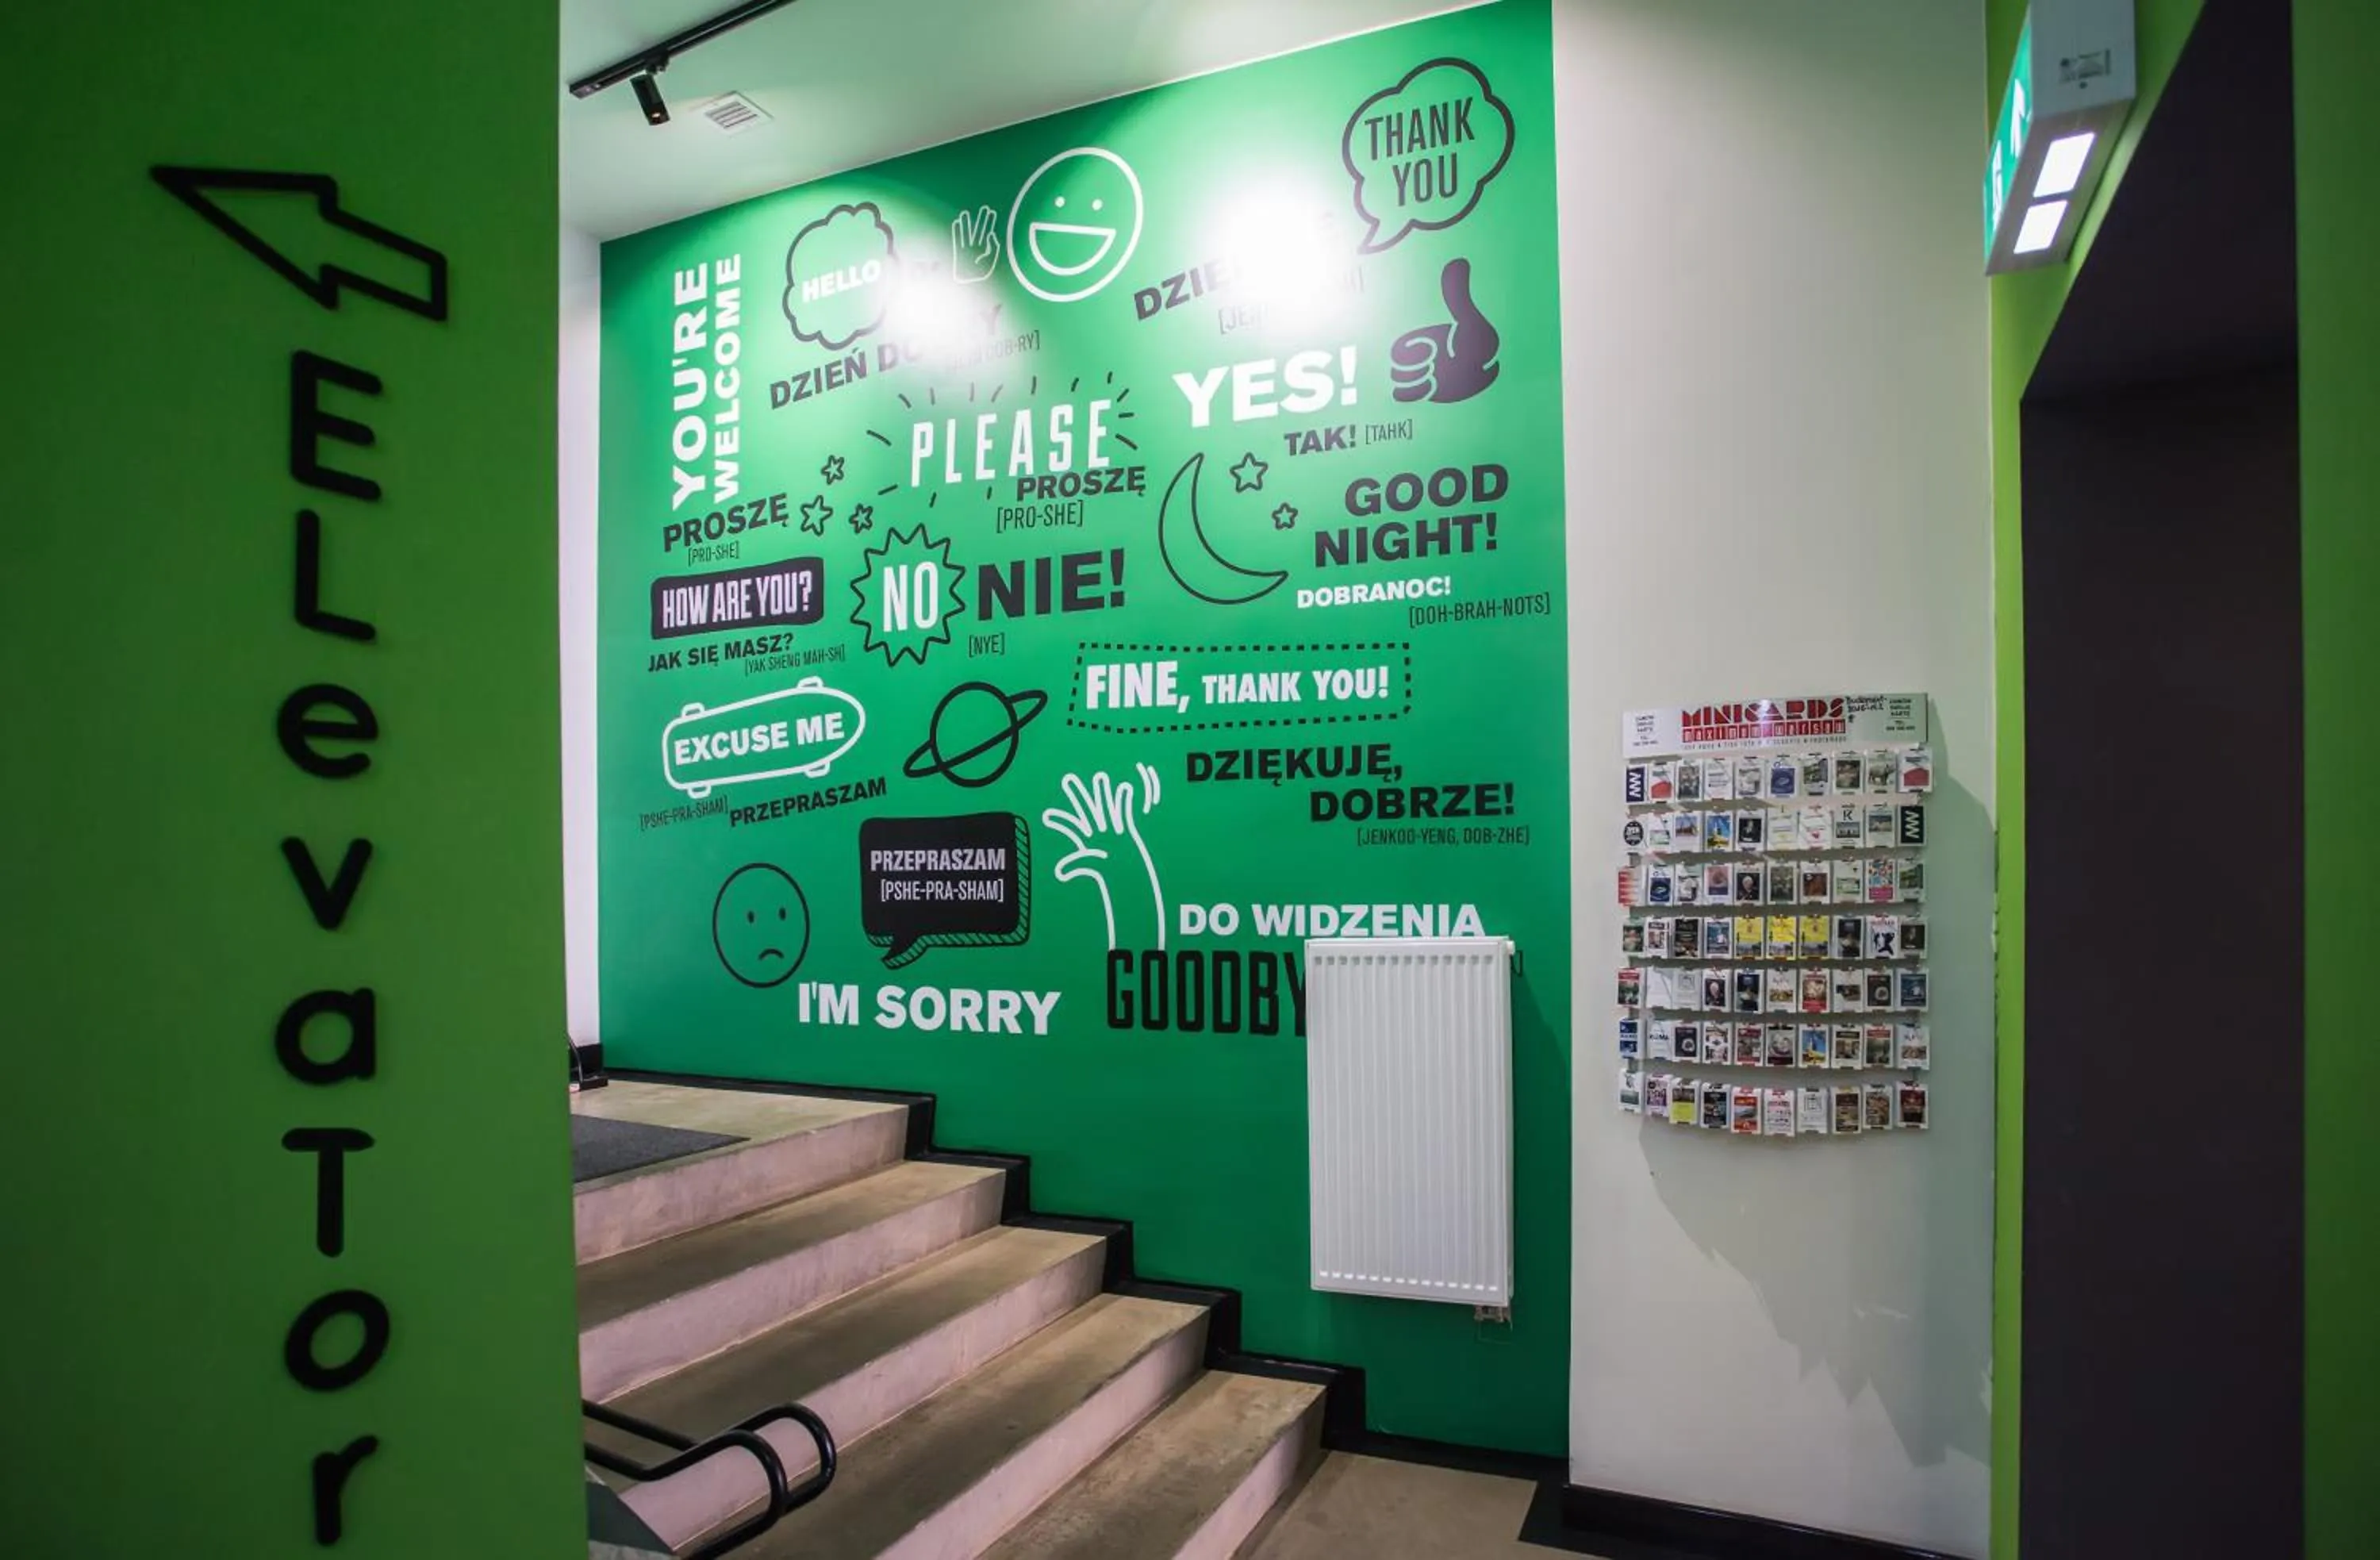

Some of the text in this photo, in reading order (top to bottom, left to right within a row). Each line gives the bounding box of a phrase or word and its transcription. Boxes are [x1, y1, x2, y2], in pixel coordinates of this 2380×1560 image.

[1364, 96, 1476, 161] THANK
[1392, 153, 1459, 207] YOU
[802, 259, 881, 302] HELLO
[672, 263, 708, 510] YOU'RE
[715, 254, 740, 502] WELCOME
[770, 347, 867, 409] DZIEŃ
[1172, 345, 1357, 428] YES!
[912, 399, 1111, 487] PLEASE
[1284, 418, 1412, 456] TAK! [TAHK]
[1016, 466, 1146, 501] PROSZĘ
[1345, 463, 1509, 517] GOOD
[662, 493, 789, 552] PROSZĘ
[996, 499, 1084, 533] [PRO-SHE]
[1315, 512, 1498, 568] NIGHT!
[662, 571, 812, 629] HOW ARE YOU?
[883, 561, 939, 632] NO
[977, 548, 1125, 621] NIE!
[1296, 576, 1451, 609] DOBRANOC!
[647, 632, 794, 672] JAK SIĘ MASZ?
[768, 651, 800, 670] SHENG
[969, 633, 1006, 657] [NYE]
[1086, 660, 1389, 713] FINE, THANK YOU!
[1682, 697, 1844, 727] MINICARDS
[674, 713, 845, 766] EXCUSE ME
[1186, 743, 1403, 786] DZIĘKUJĘ,
[729, 776, 887, 828] PRZEPRASZAM
[1310, 782, 1515, 822] DOBRZE!
[870, 847, 1006, 872] PRZEPRASZAM
[881, 878, 1004, 903] [PSHE-PRA-SHAM]
[1179, 904, 1486, 937] DO WIDZENIA
[798, 982, 1061, 1036] I'M SORRY
[1107, 950, 1307, 1037] GOODBY
